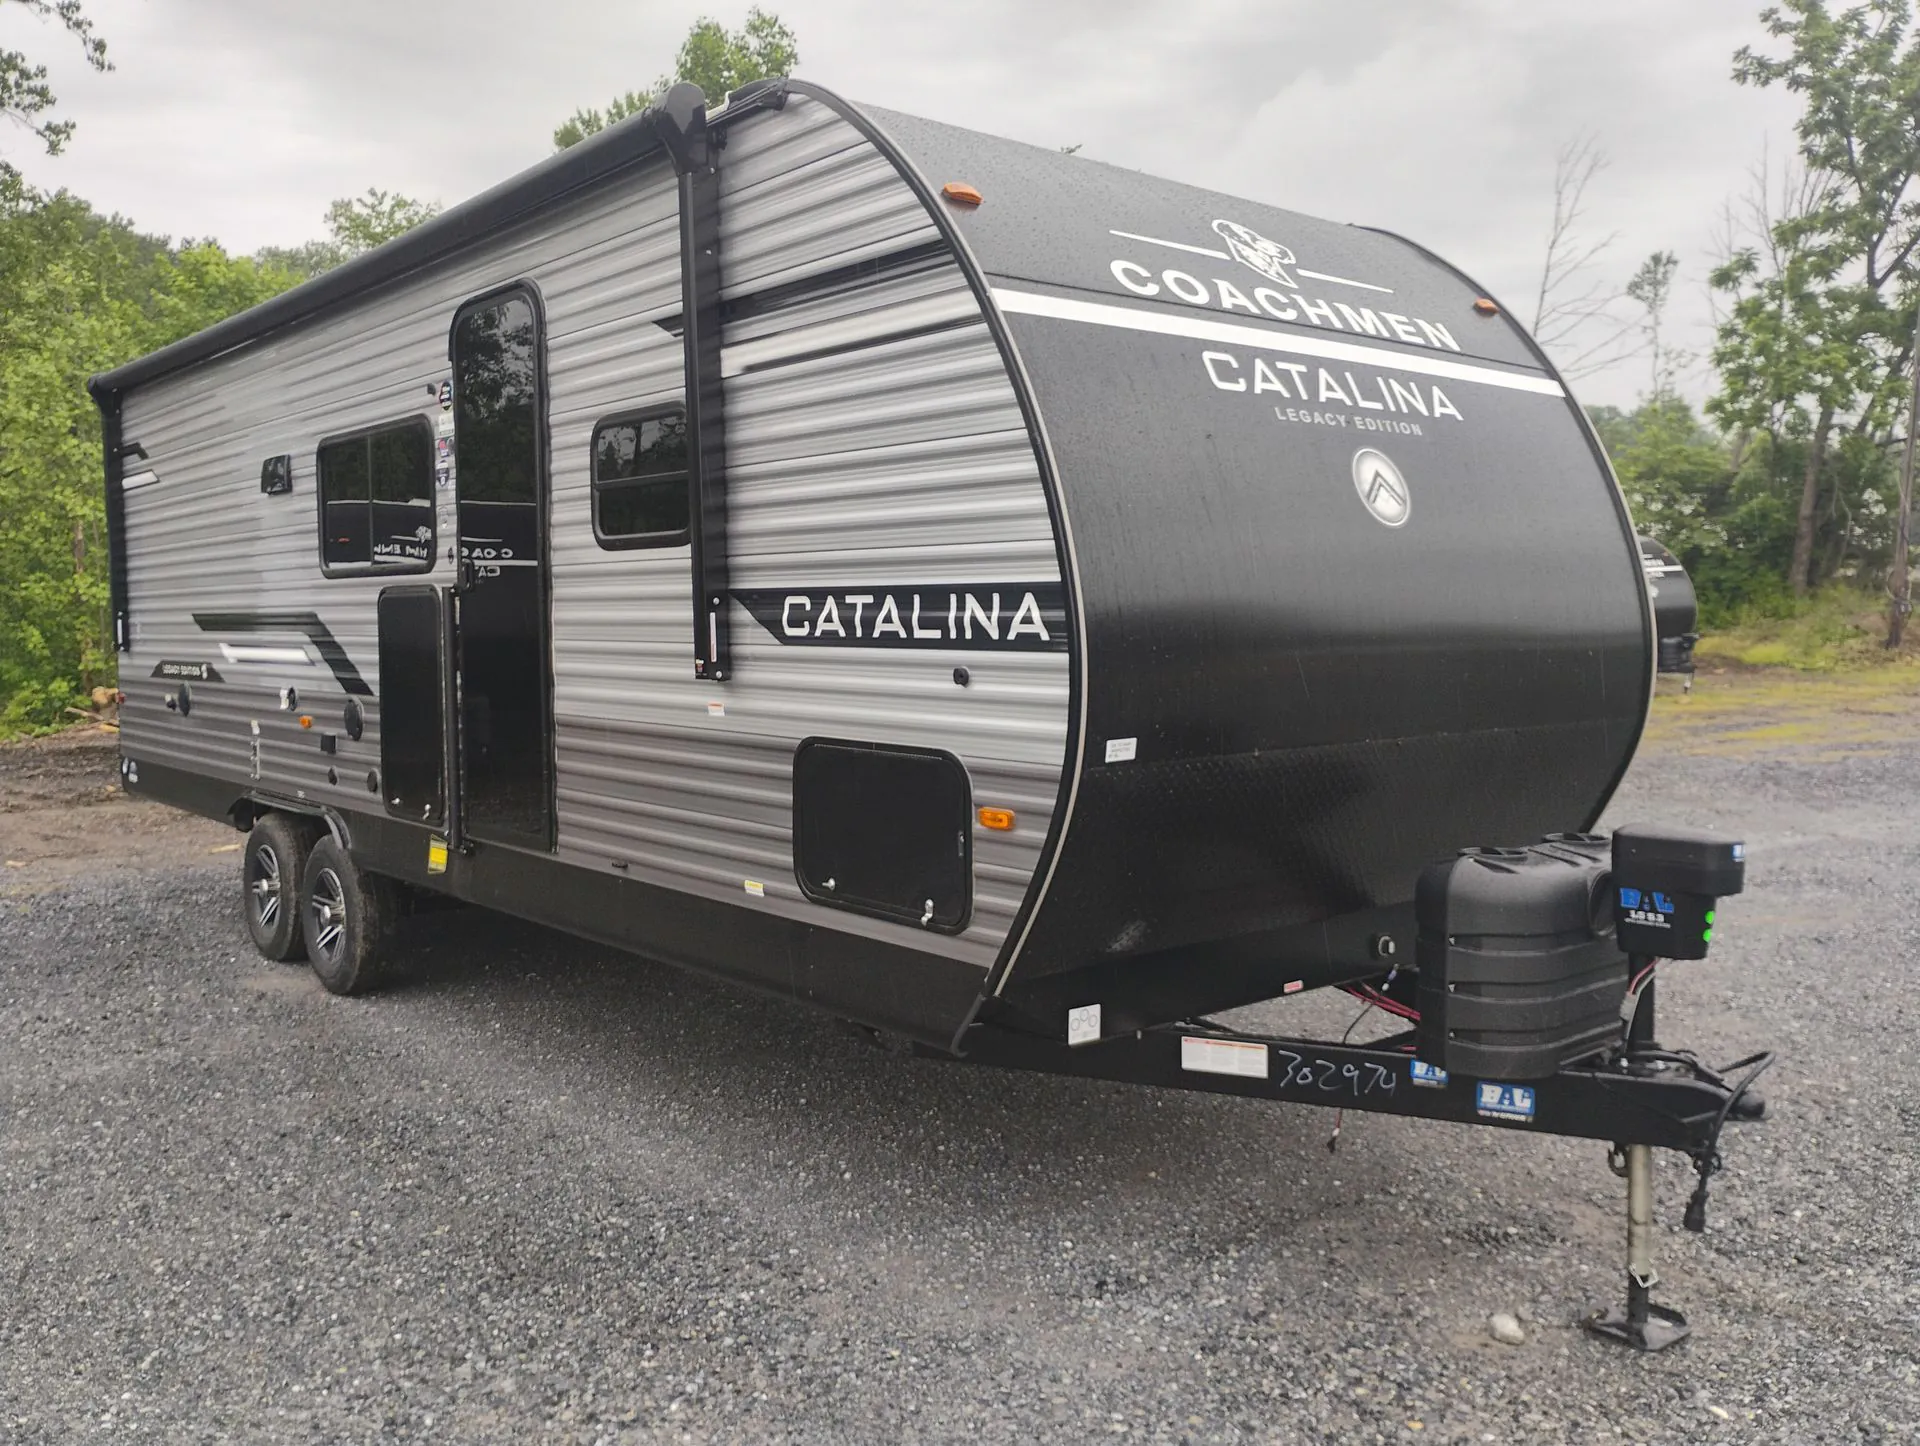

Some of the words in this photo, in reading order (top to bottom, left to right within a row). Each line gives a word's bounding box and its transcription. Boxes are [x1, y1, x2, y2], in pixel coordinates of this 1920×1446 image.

[1110, 259, 1462, 352] COACHMEN
[1202, 351, 1464, 421] CATALINA
[1274, 406, 1347, 428] LEGACY
[1353, 416, 1423, 436] EDITION
[781, 591, 1051, 641] CATALINA
[1278, 1050, 1396, 1097] 302974
